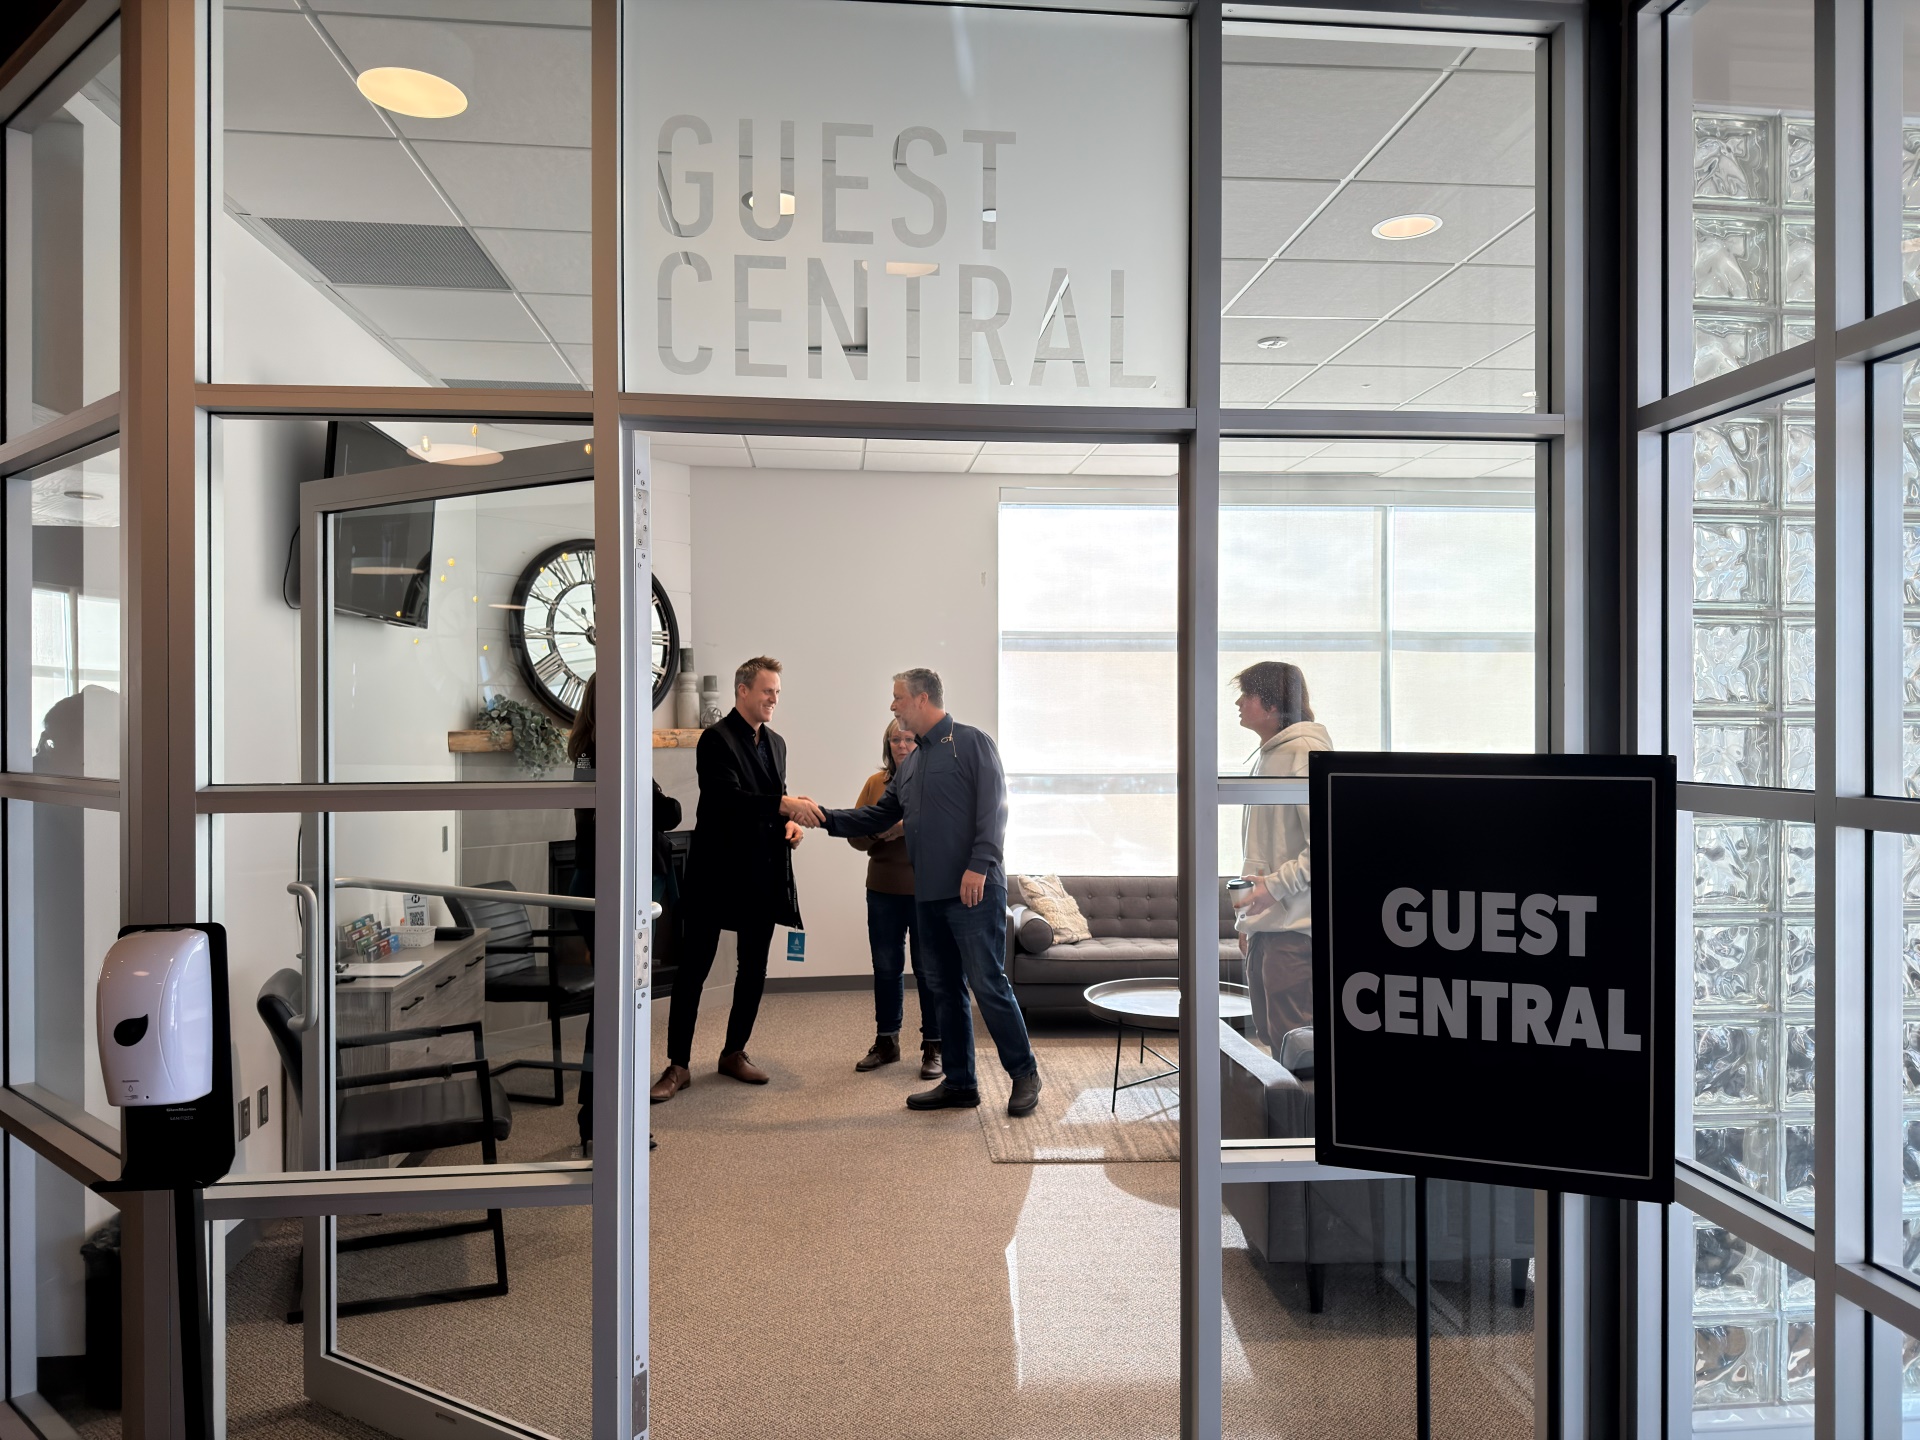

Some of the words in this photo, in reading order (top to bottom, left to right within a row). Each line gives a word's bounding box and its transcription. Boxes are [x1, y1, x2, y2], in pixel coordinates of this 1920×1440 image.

[657, 114, 1016, 250] GUEST
[657, 251, 1157, 388] CENTRAL
[1381, 887, 1598, 957] GUEST
[1341, 971, 1642, 1052] CENTRAL
